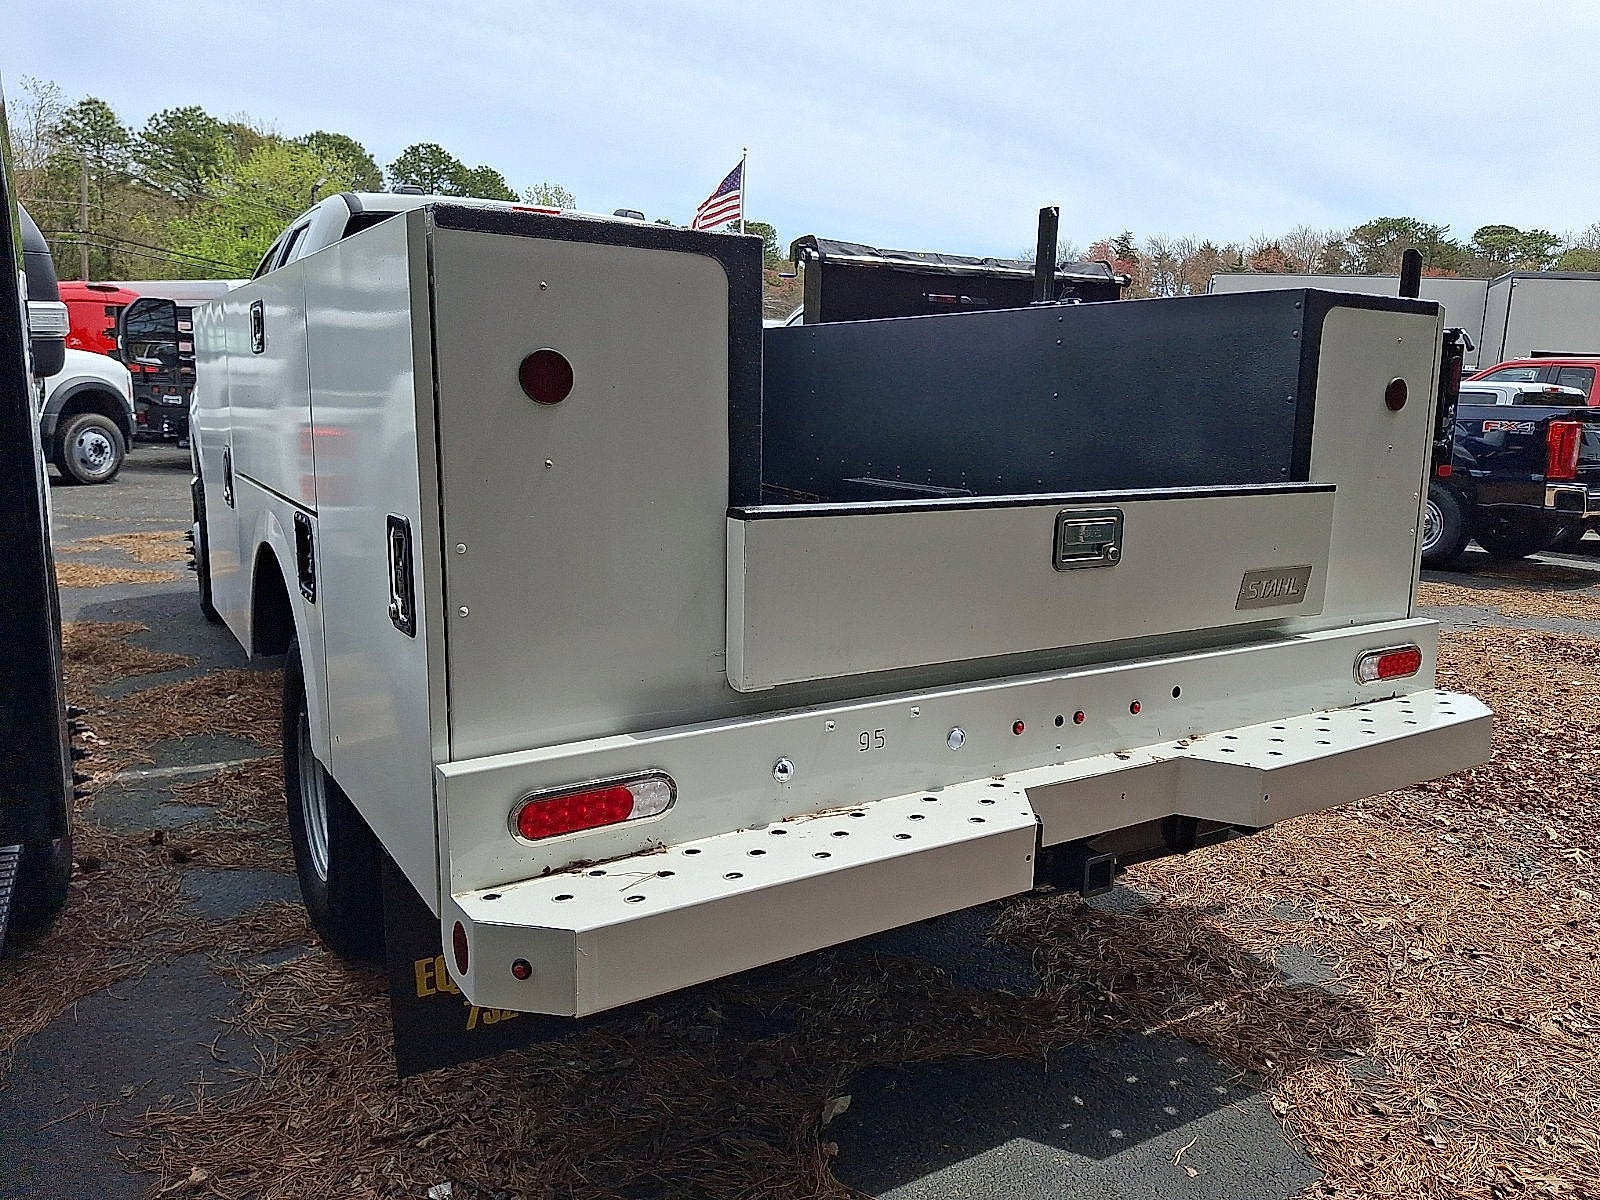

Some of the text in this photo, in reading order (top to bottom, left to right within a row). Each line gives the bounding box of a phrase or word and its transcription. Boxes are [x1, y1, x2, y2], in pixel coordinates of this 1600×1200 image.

[1482, 420, 1535, 432] FX4
[1246, 577, 1300, 600] STAHL
[859, 728, 885, 752] 95
